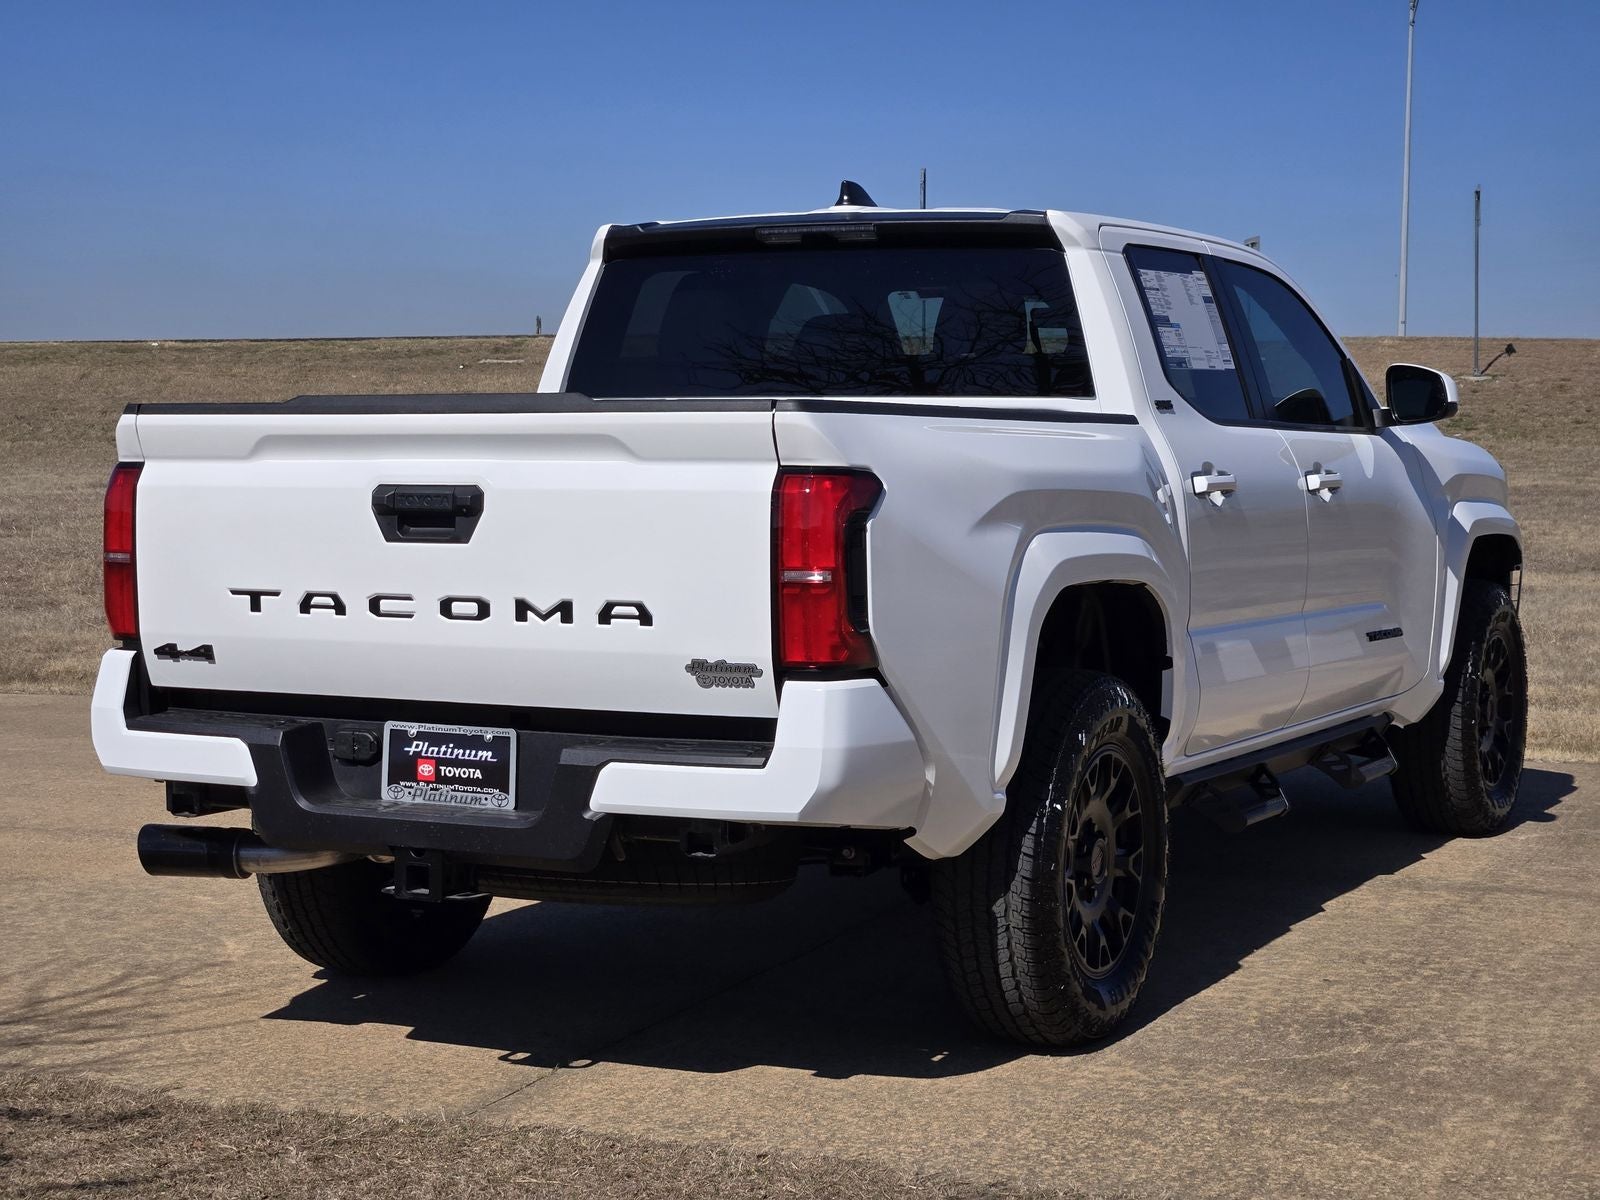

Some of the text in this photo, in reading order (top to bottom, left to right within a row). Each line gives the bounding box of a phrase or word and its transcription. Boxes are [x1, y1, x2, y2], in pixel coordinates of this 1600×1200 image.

[396, 495, 449, 507] TOYOTA
[228, 588, 654, 627] TACOMA
[686, 660, 762, 676] Platinum
[712, 676, 753, 687] TOYOTA
[391, 723, 510, 736] www.PlatinumToyota.com
[404, 741, 498, 762] Platinum
[439, 766, 482, 779] TOYOTA
[411, 786, 488, 806] Platinum
